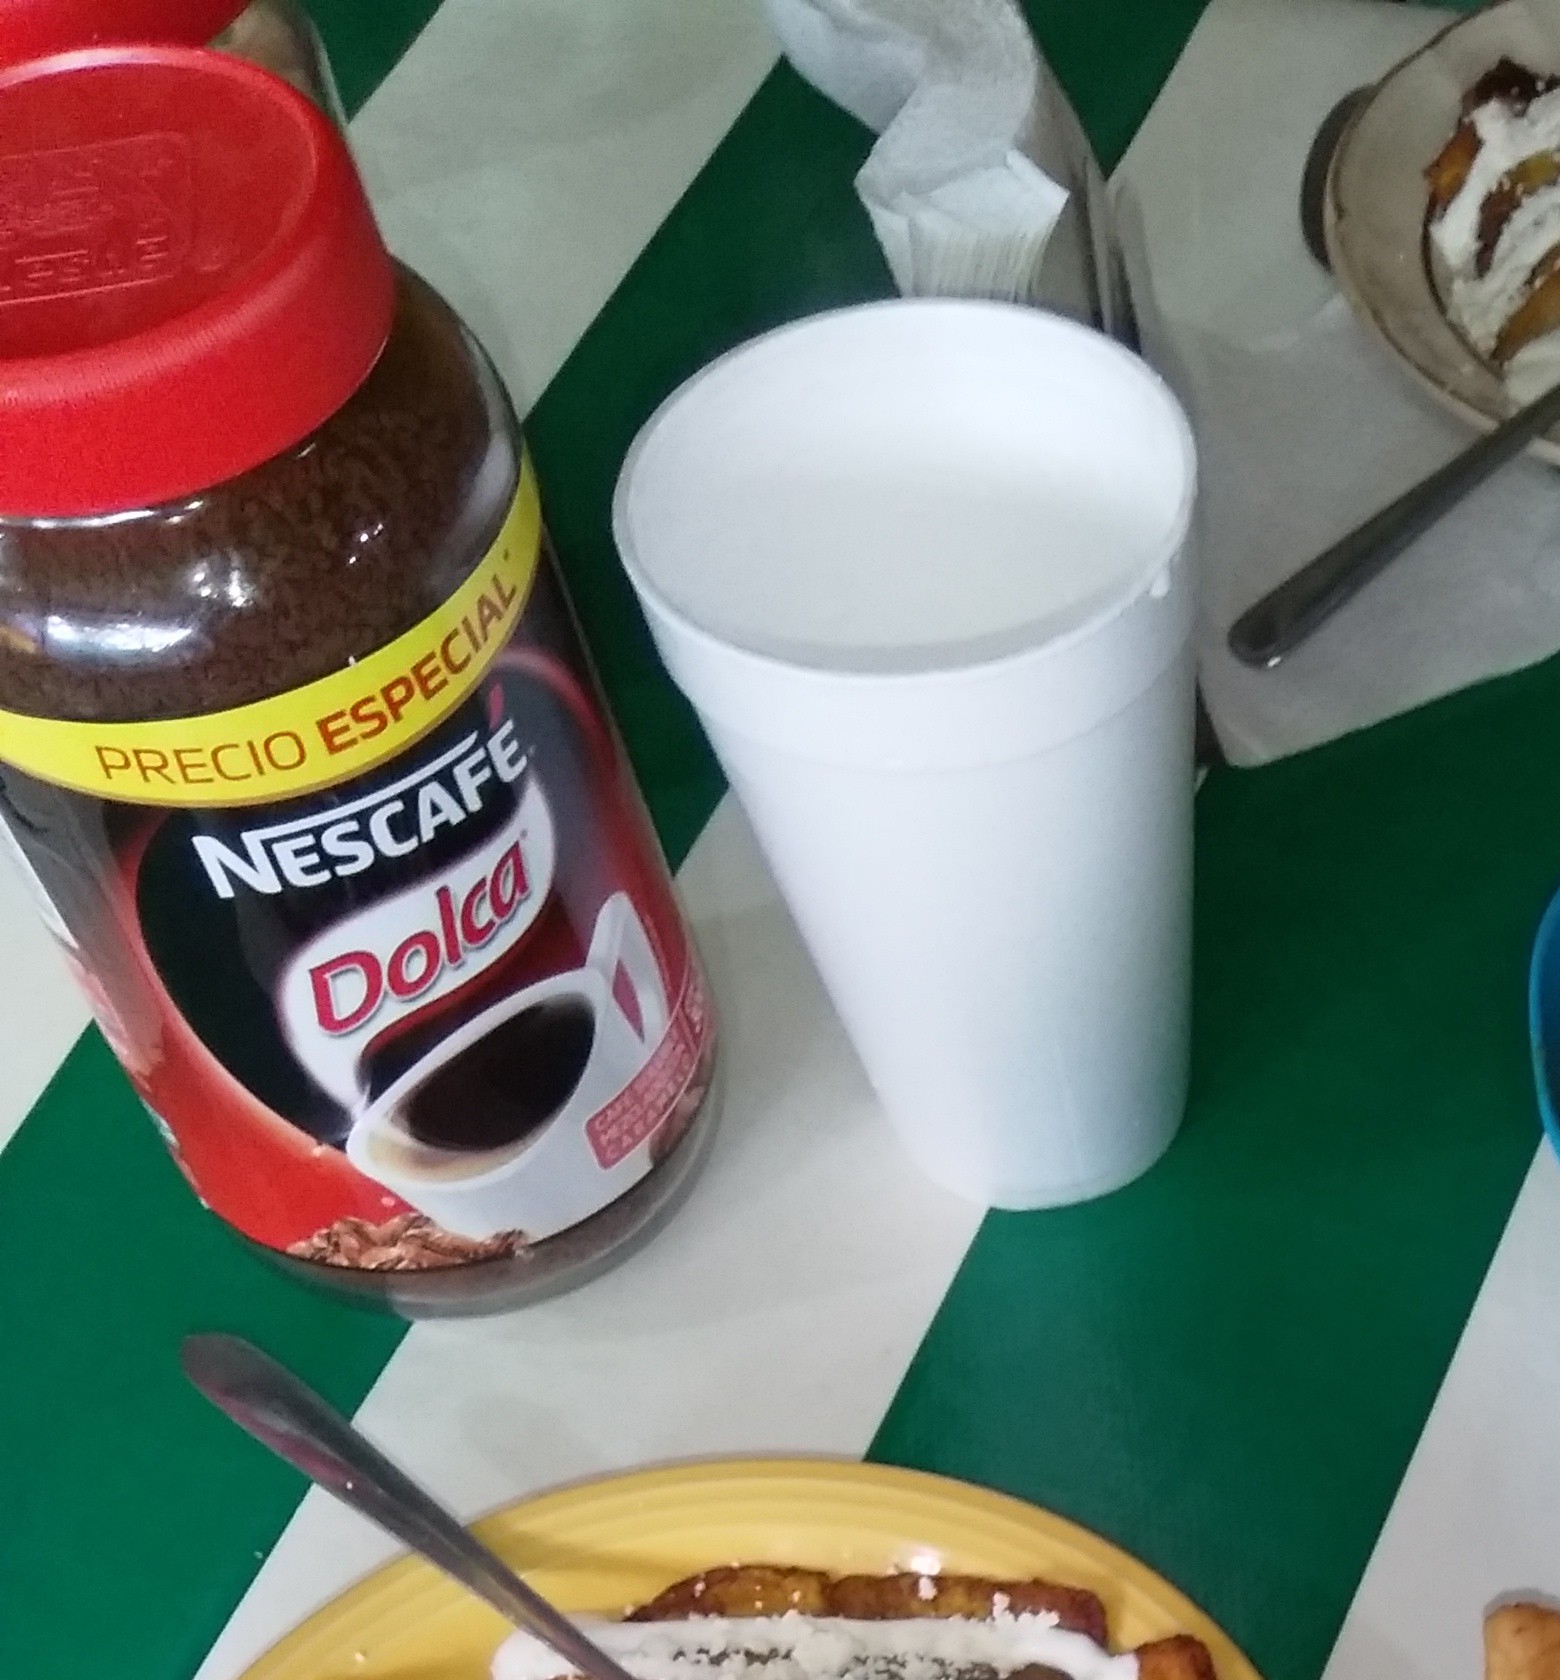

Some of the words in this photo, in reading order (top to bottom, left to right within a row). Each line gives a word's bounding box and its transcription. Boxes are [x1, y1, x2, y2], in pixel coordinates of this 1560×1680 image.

[94, 730, 307, 785] PRECIO
[315, 572, 517, 756] ESPECIAL
[190, 683, 528, 899] NESCAFÉ
[308, 837, 531, 1036] Dolca
